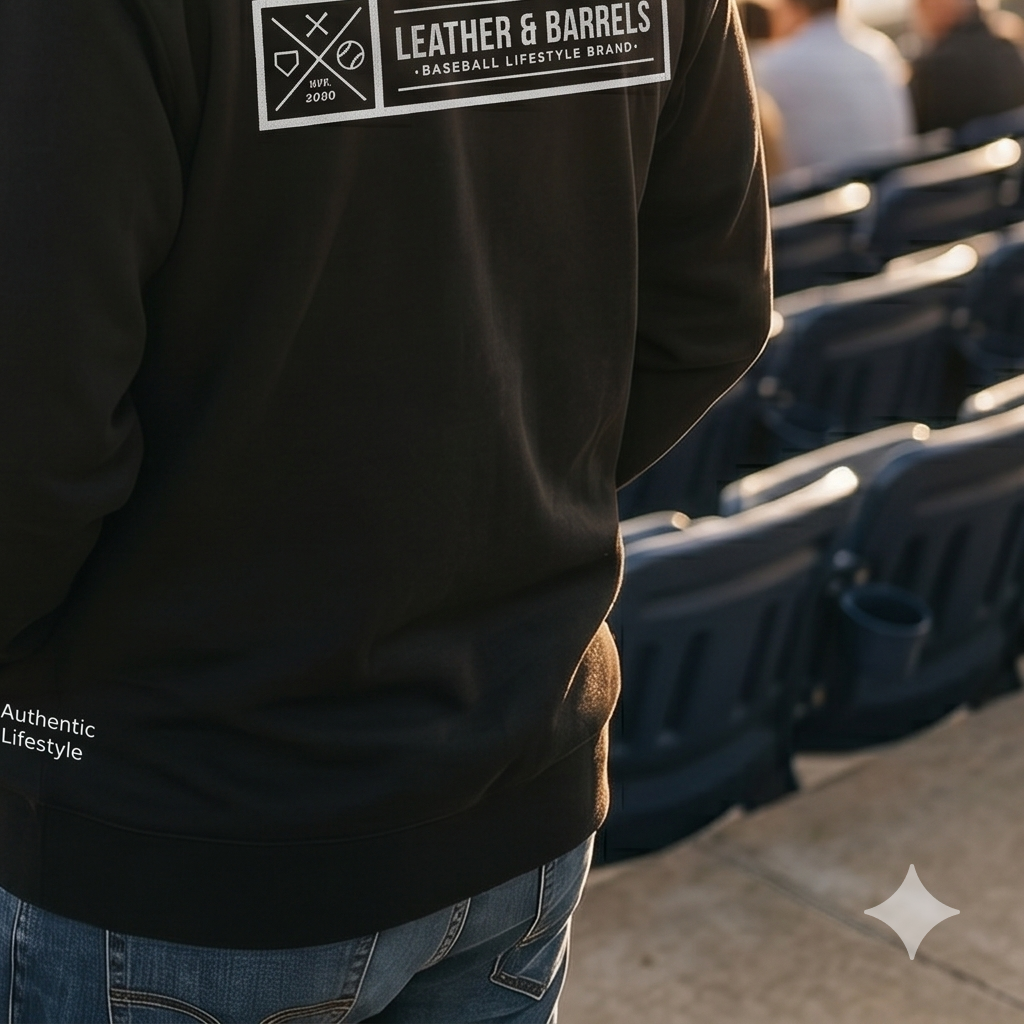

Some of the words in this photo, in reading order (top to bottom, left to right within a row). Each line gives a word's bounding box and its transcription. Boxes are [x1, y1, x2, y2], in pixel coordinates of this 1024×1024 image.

[395, 15, 512, 61] LEATHER
[520, 12, 537, 46] &
[545, 0, 651, 44] BARRELS
[422, 57, 500, 77] BASEBALL
[505, 47, 581, 67] LIFESTYLE
[586, 41, 632, 57] BRAND
[0, 703, 96, 739] Authentic
[1, 727, 83, 761] Lifestyle
